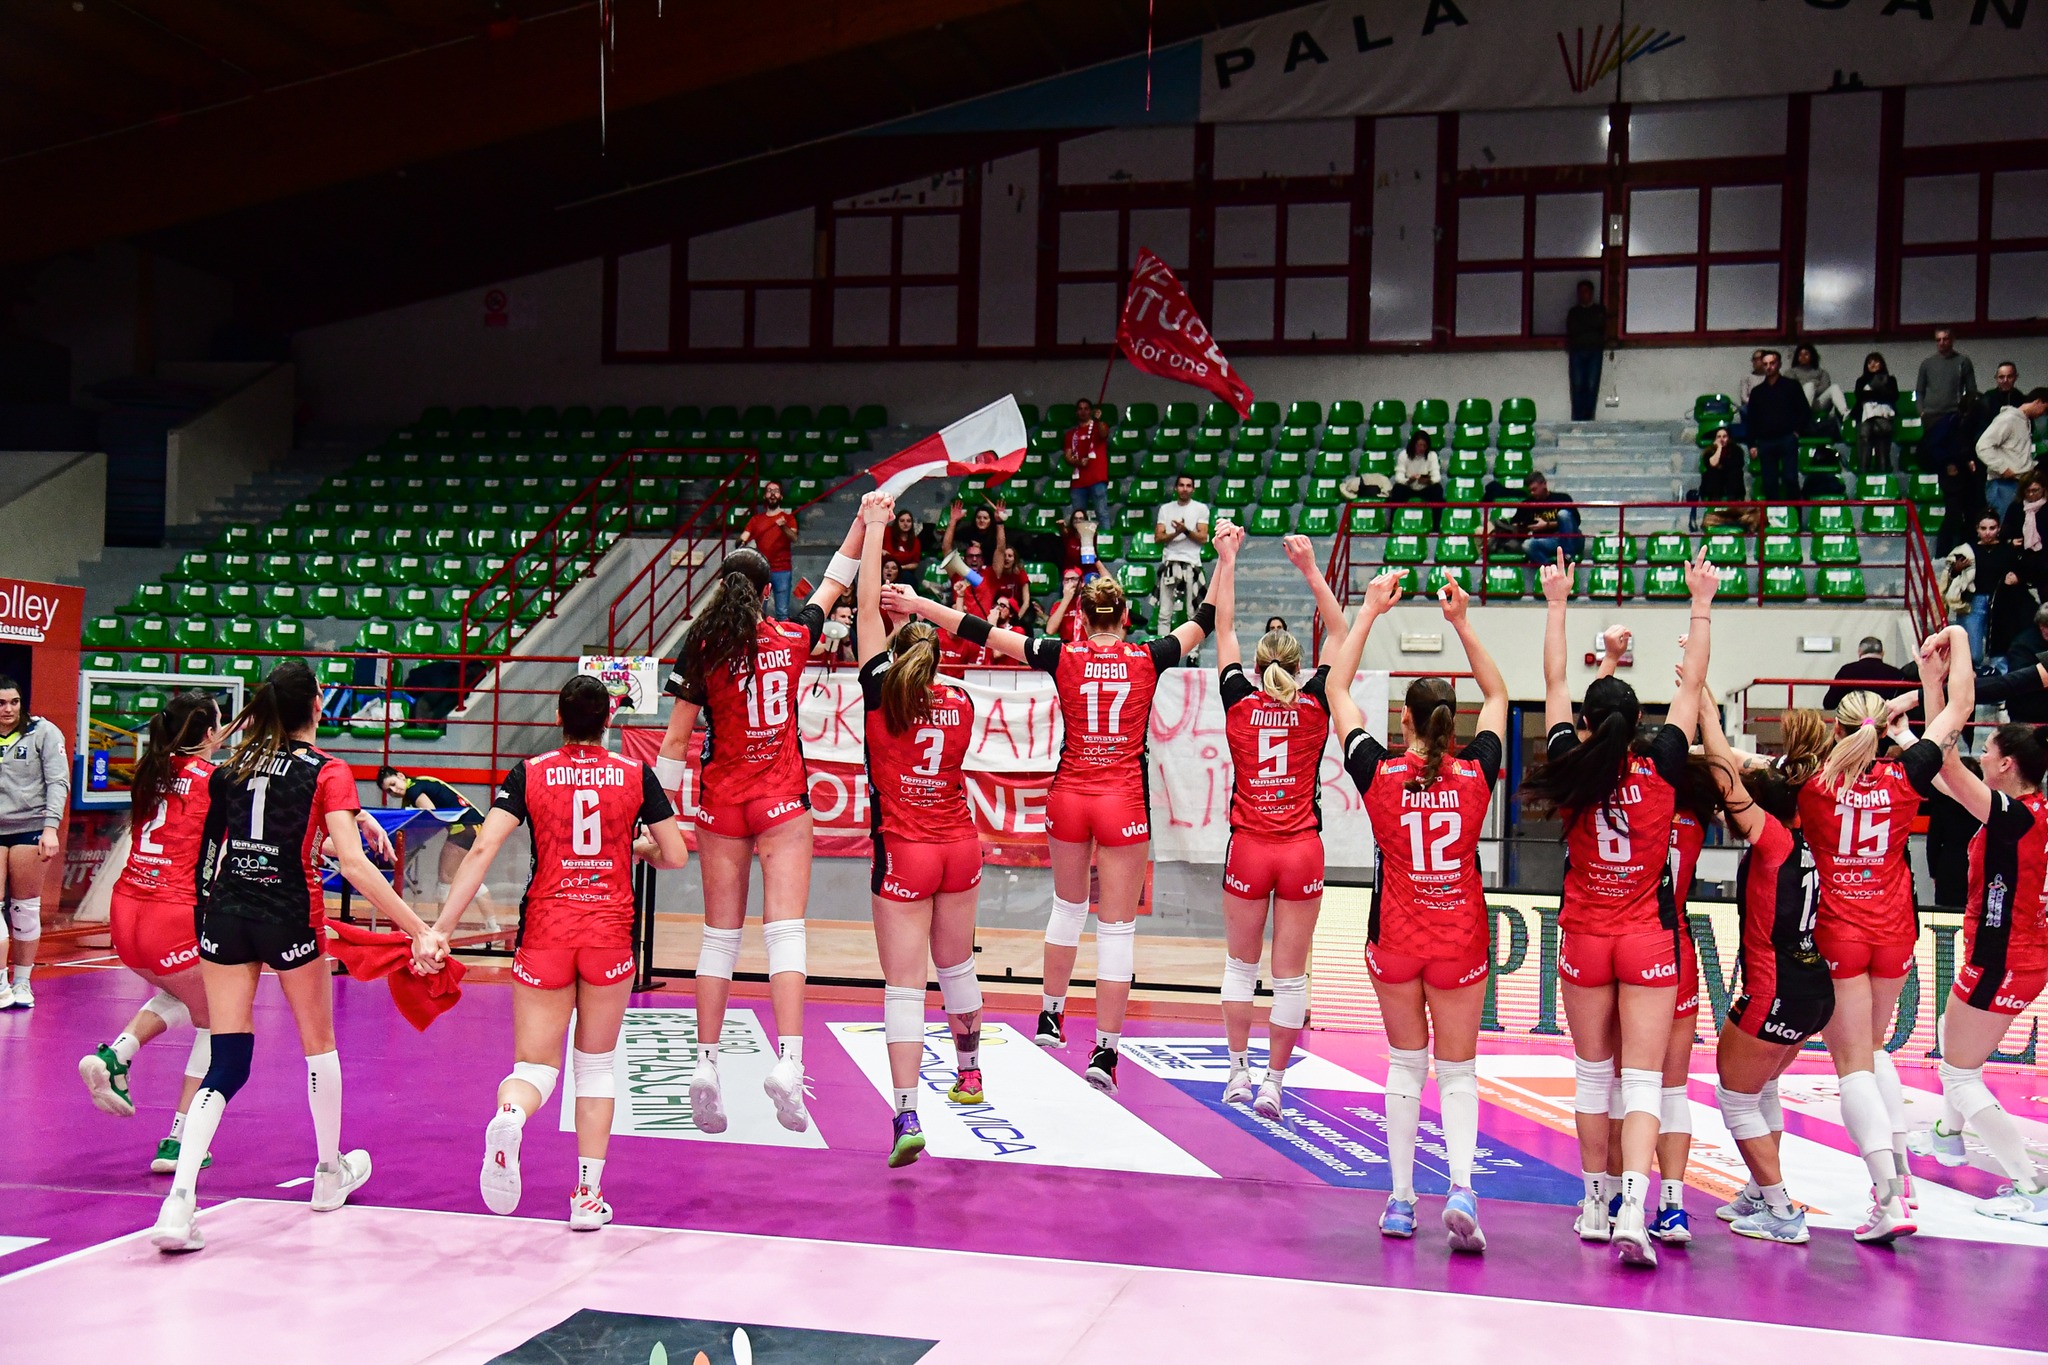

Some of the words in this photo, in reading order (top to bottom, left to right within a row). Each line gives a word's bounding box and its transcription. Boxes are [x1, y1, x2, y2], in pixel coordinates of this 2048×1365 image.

[1134, 338, 1166, 362] for
[1169, 352, 1209, 377] one
[0, 584, 59, 631] olley
[0, 622, 42, 637] iovani
[758, 648, 792, 670] CORE
[1084, 662, 1128, 680] BOSSO
[738, 670, 789, 728] 18
[1079, 681, 1131, 734] 17
[1250, 709, 1300, 727] MONZA
[913, 728, 945, 777] 3
[1258, 729, 1289, 778] 5
[546, 764, 624, 788] CONCEIÇÃO
[899, 774, 948, 787] Vematron
[1249, 777, 1297, 786] Vematron
[247, 776, 270, 840] 1
[1401, 790, 1460, 809] FURLAN
[1836, 788, 1891, 808] REBORA
[140, 799, 168, 855] 2
[572, 789, 602, 856] 6
[1833, 807, 1892, 858] 15
[1400, 811, 1462, 872] 12
[1596, 808, 1632, 863] 8
[232, 840, 280, 855] Vematron
[561, 860, 613, 869] Vematron
[1833, 856, 1885, 866] Vematron
[1226, 874, 1250, 893] viar
[1408, 872, 1462, 883] Vematron
[1833, 868, 1863, 883] ada
[884, 880, 920, 900] viar
[1435, 898, 1467, 906] VOGUE
[200, 931, 218, 953] iar
[281, 938, 316, 962] viar
[160, 944, 200, 969] viar
[605, 955, 634, 980] viar
[513, 961, 541, 986] viar
[1459, 960, 1488, 985] viar
[1642, 963, 1677, 980] viar
[1764, 1022, 1803, 1041] viar
